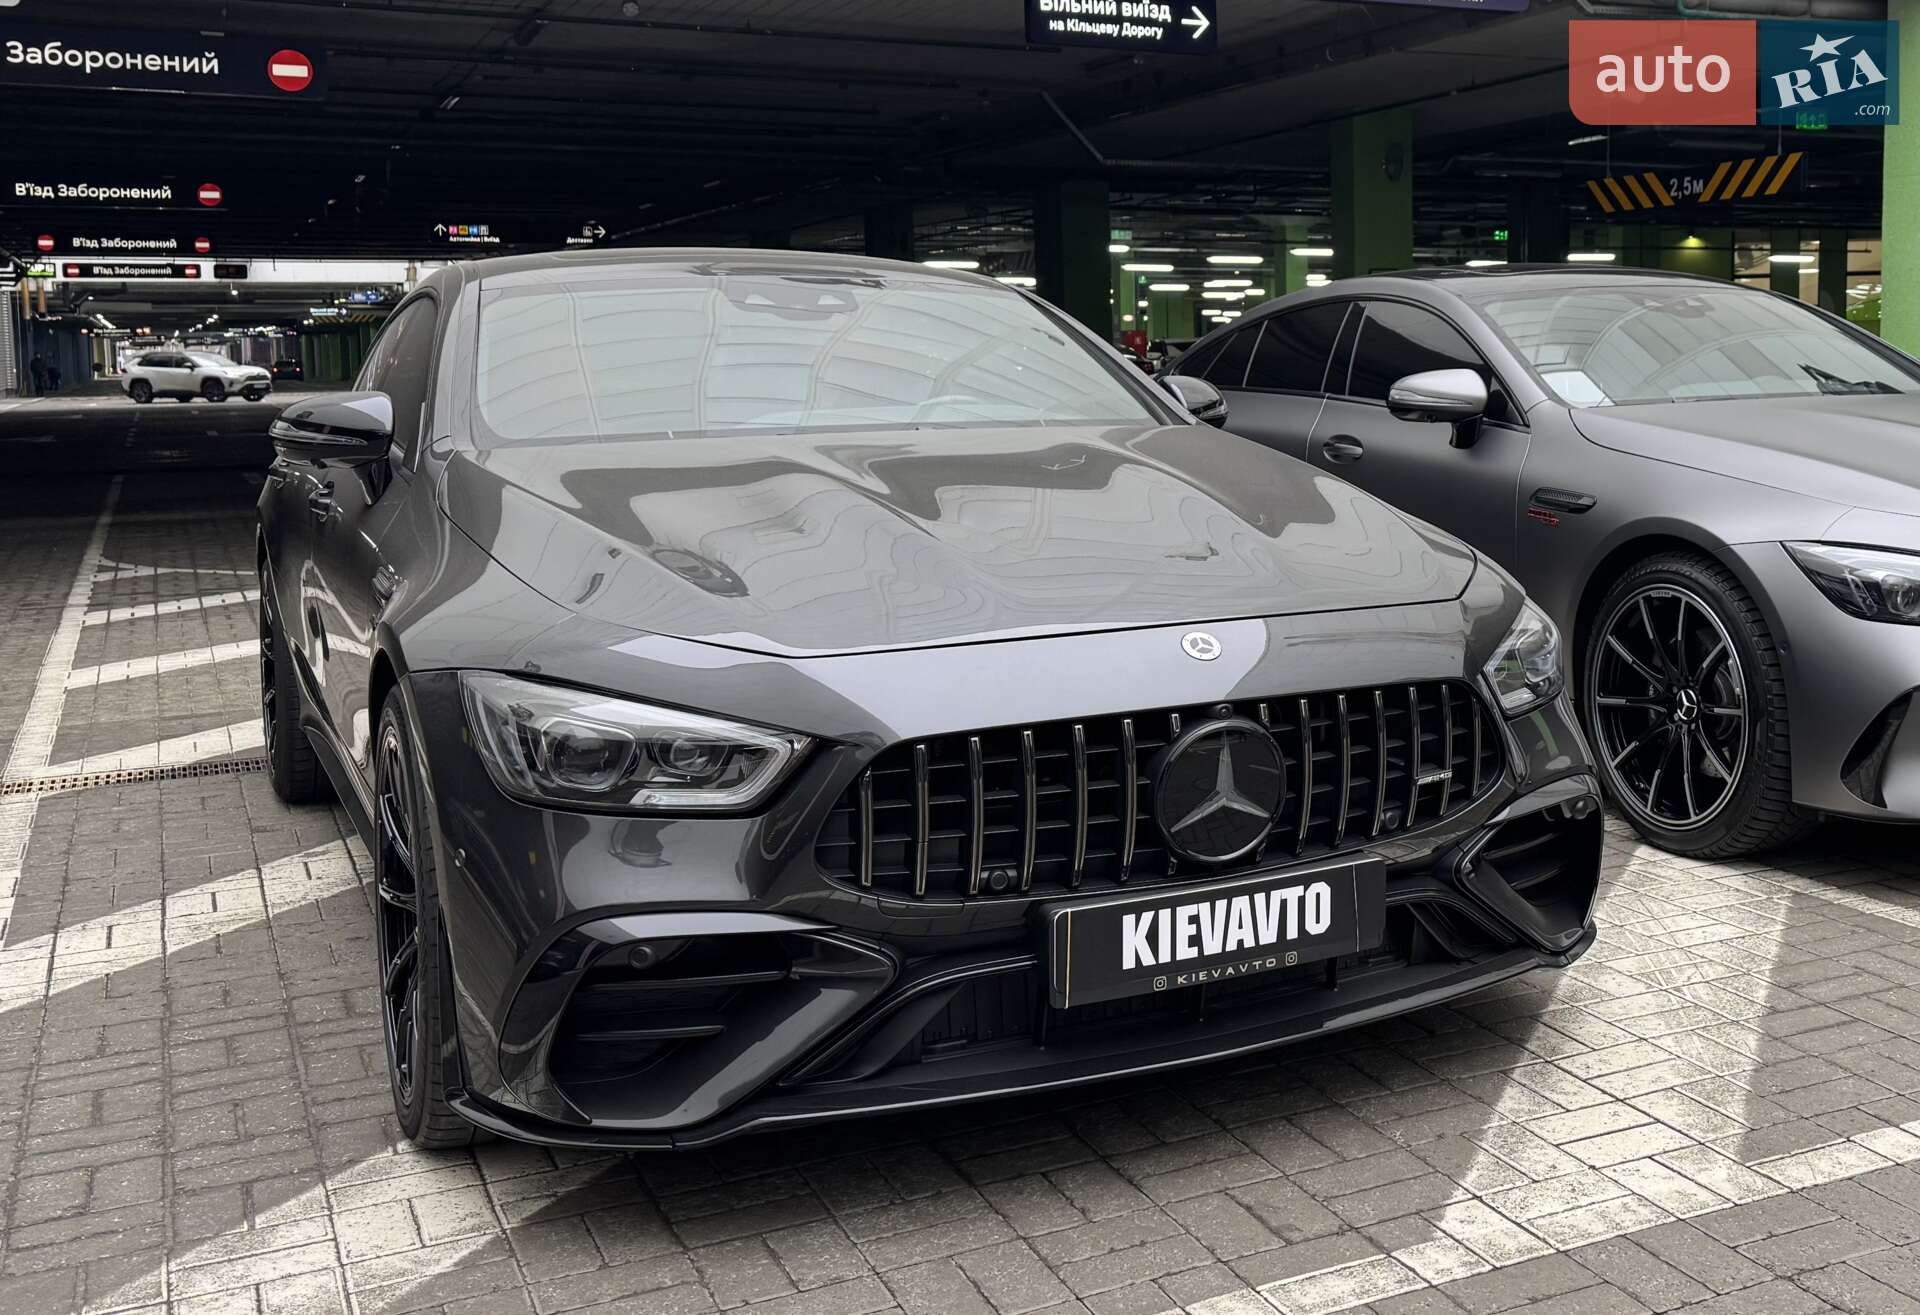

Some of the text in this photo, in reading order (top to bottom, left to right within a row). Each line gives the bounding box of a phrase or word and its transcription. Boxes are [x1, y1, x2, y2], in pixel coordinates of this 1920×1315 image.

[1121, 0, 1172, 22] виїзд
[1049, 18, 1164, 40] на Кільцеву Дорогу
[5, 40, 219, 75] Заборонений
[15, 182, 172, 200] В'їзд Заборонений
[72, 237, 177, 250] В'їзд Заборонений
[114, 266, 172, 275] Заборонений
[1122, 881, 1331, 970] KIEVAVTO
[1177, 957, 1277, 985] KIEVAVTO
